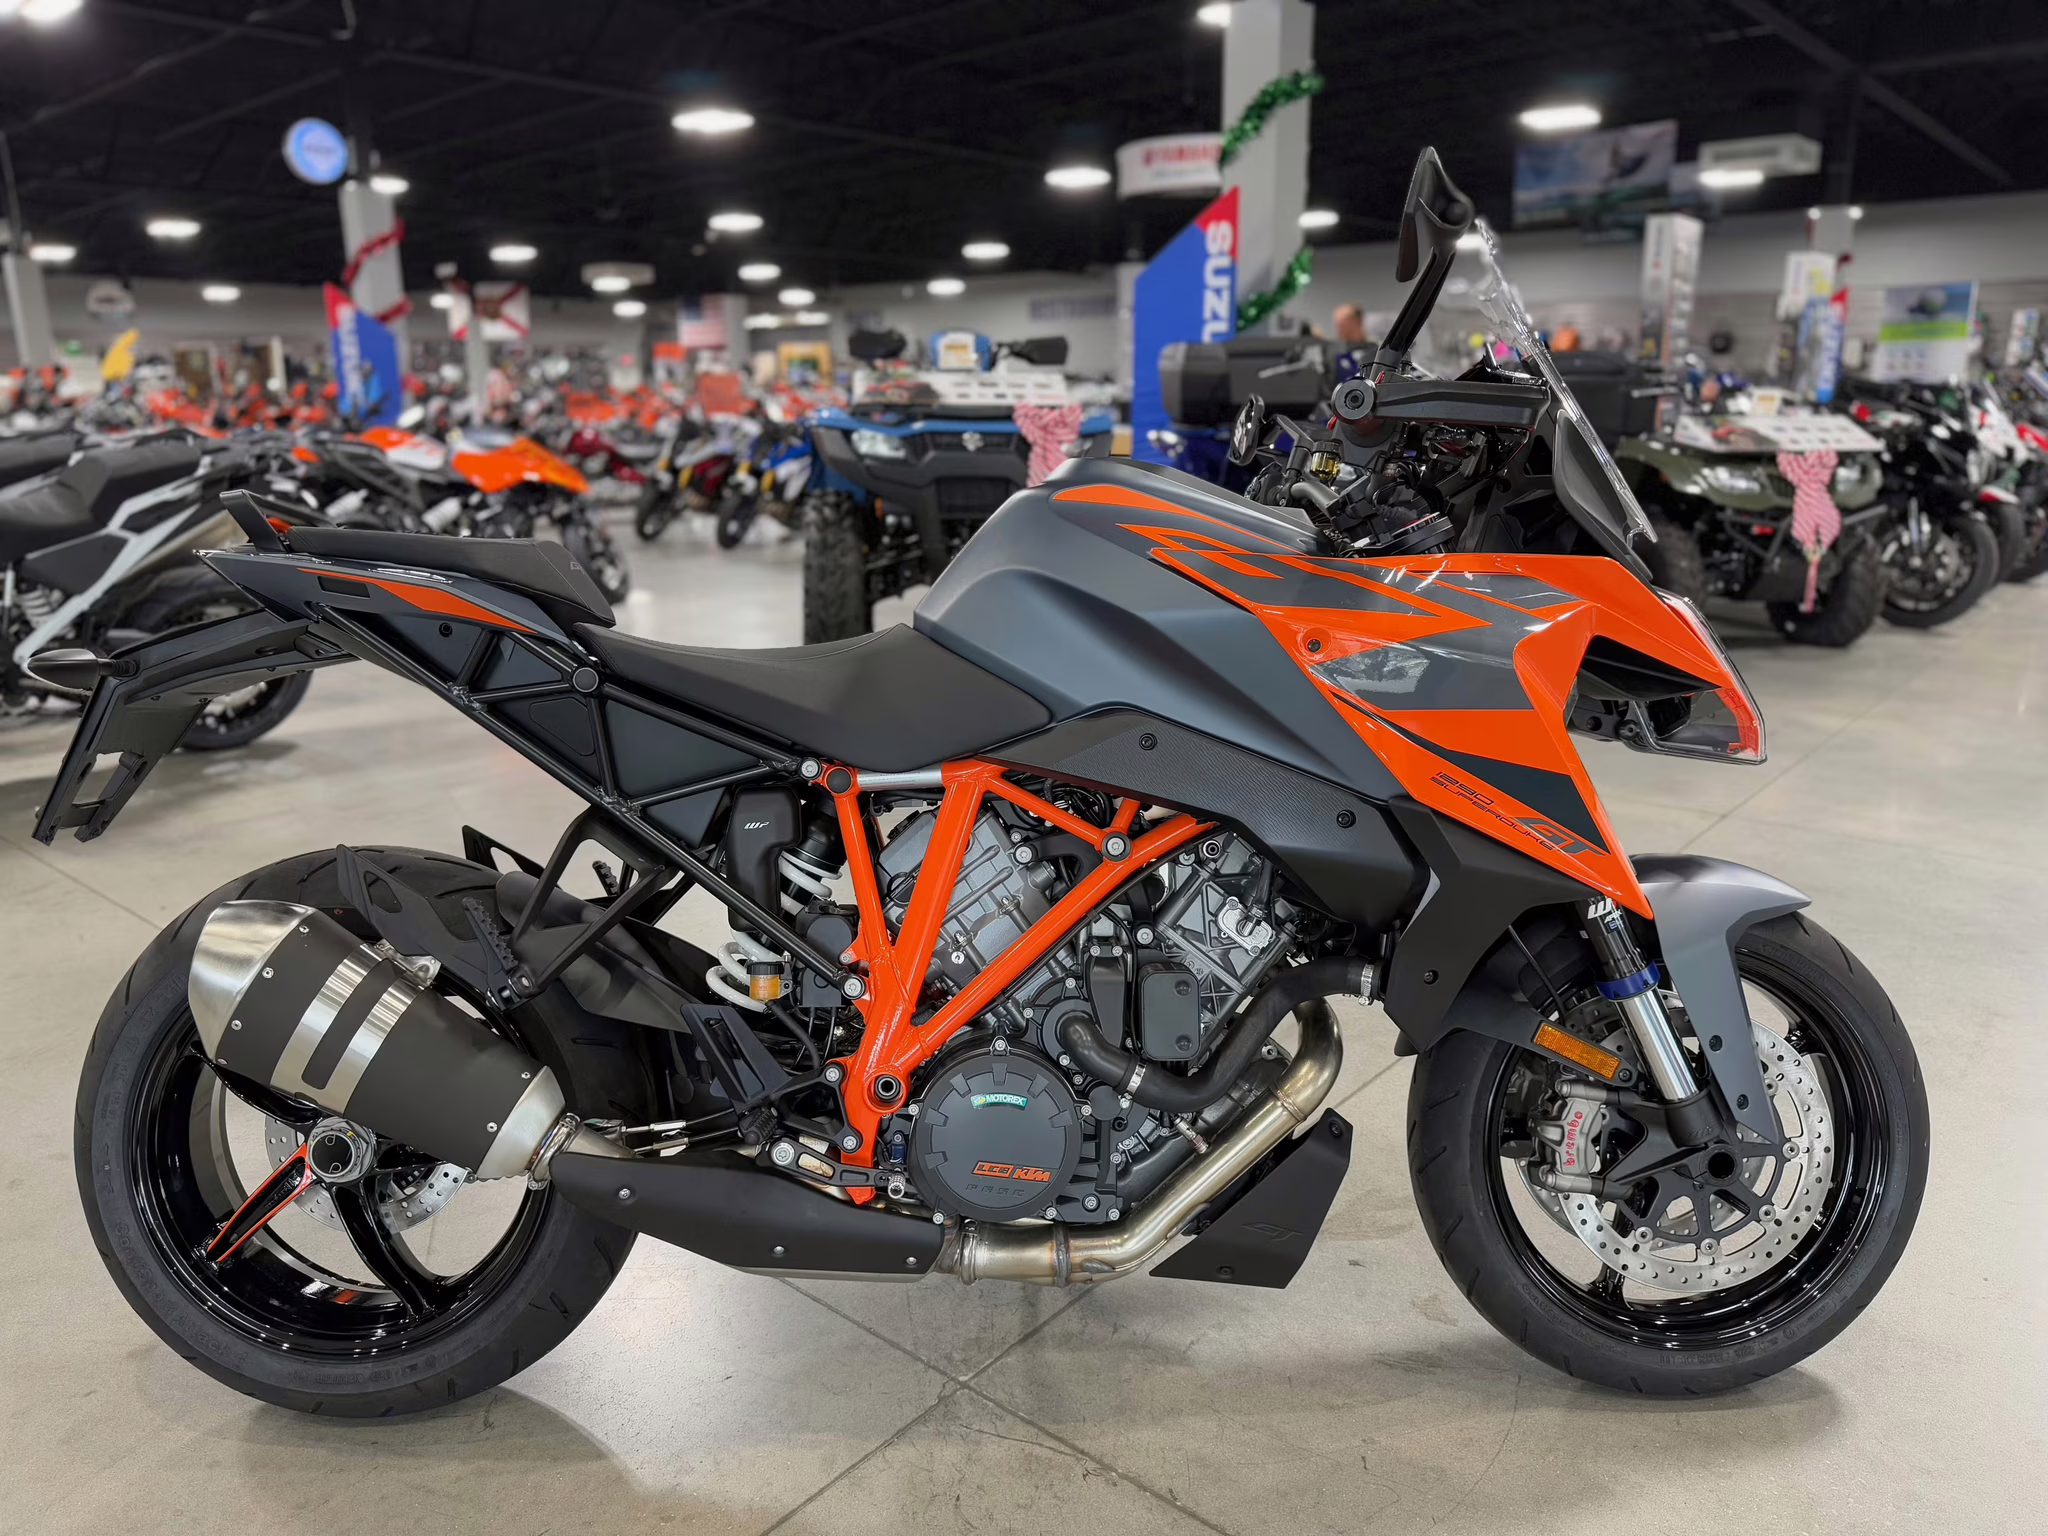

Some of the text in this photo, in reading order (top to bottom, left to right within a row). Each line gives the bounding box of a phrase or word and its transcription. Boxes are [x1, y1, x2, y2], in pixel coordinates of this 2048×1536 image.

[1436, 771, 1494, 807] 1290
[1508, 817, 1607, 856] GT
[985, 1093, 1025, 1106] MOTOREX
[1564, 1111, 1583, 1167] brembo
[1013, 1167, 1051, 1182] KTM
